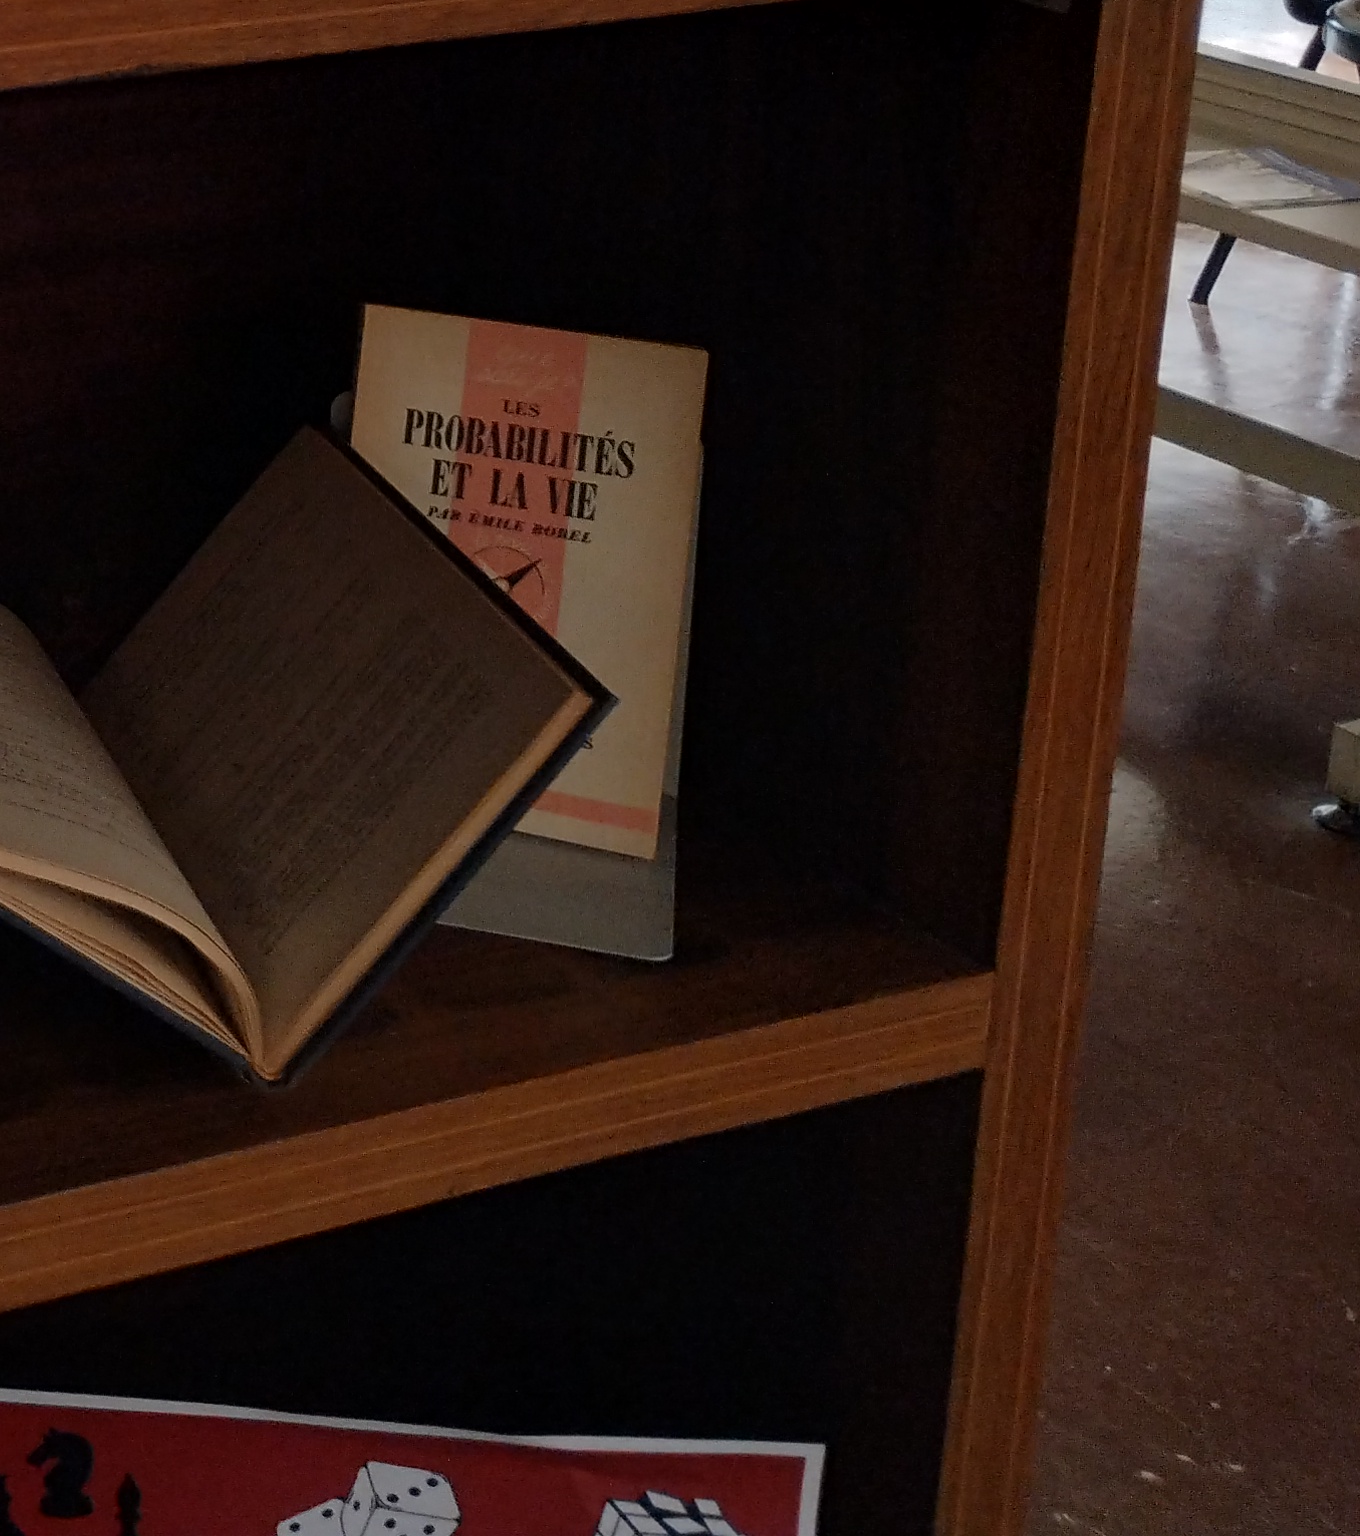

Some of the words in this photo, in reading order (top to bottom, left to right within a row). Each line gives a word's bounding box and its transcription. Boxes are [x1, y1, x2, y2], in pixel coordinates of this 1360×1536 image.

[501, 398, 540, 418] LES
[403, 407, 637, 479] PROBABILITÉS
[429, 458, 472, 501] ET
[488, 467, 528, 511] LA
[547, 478, 599, 521] VIE
[427, 505, 462, 523] PAR
[532, 523, 593, 544] BOREL
